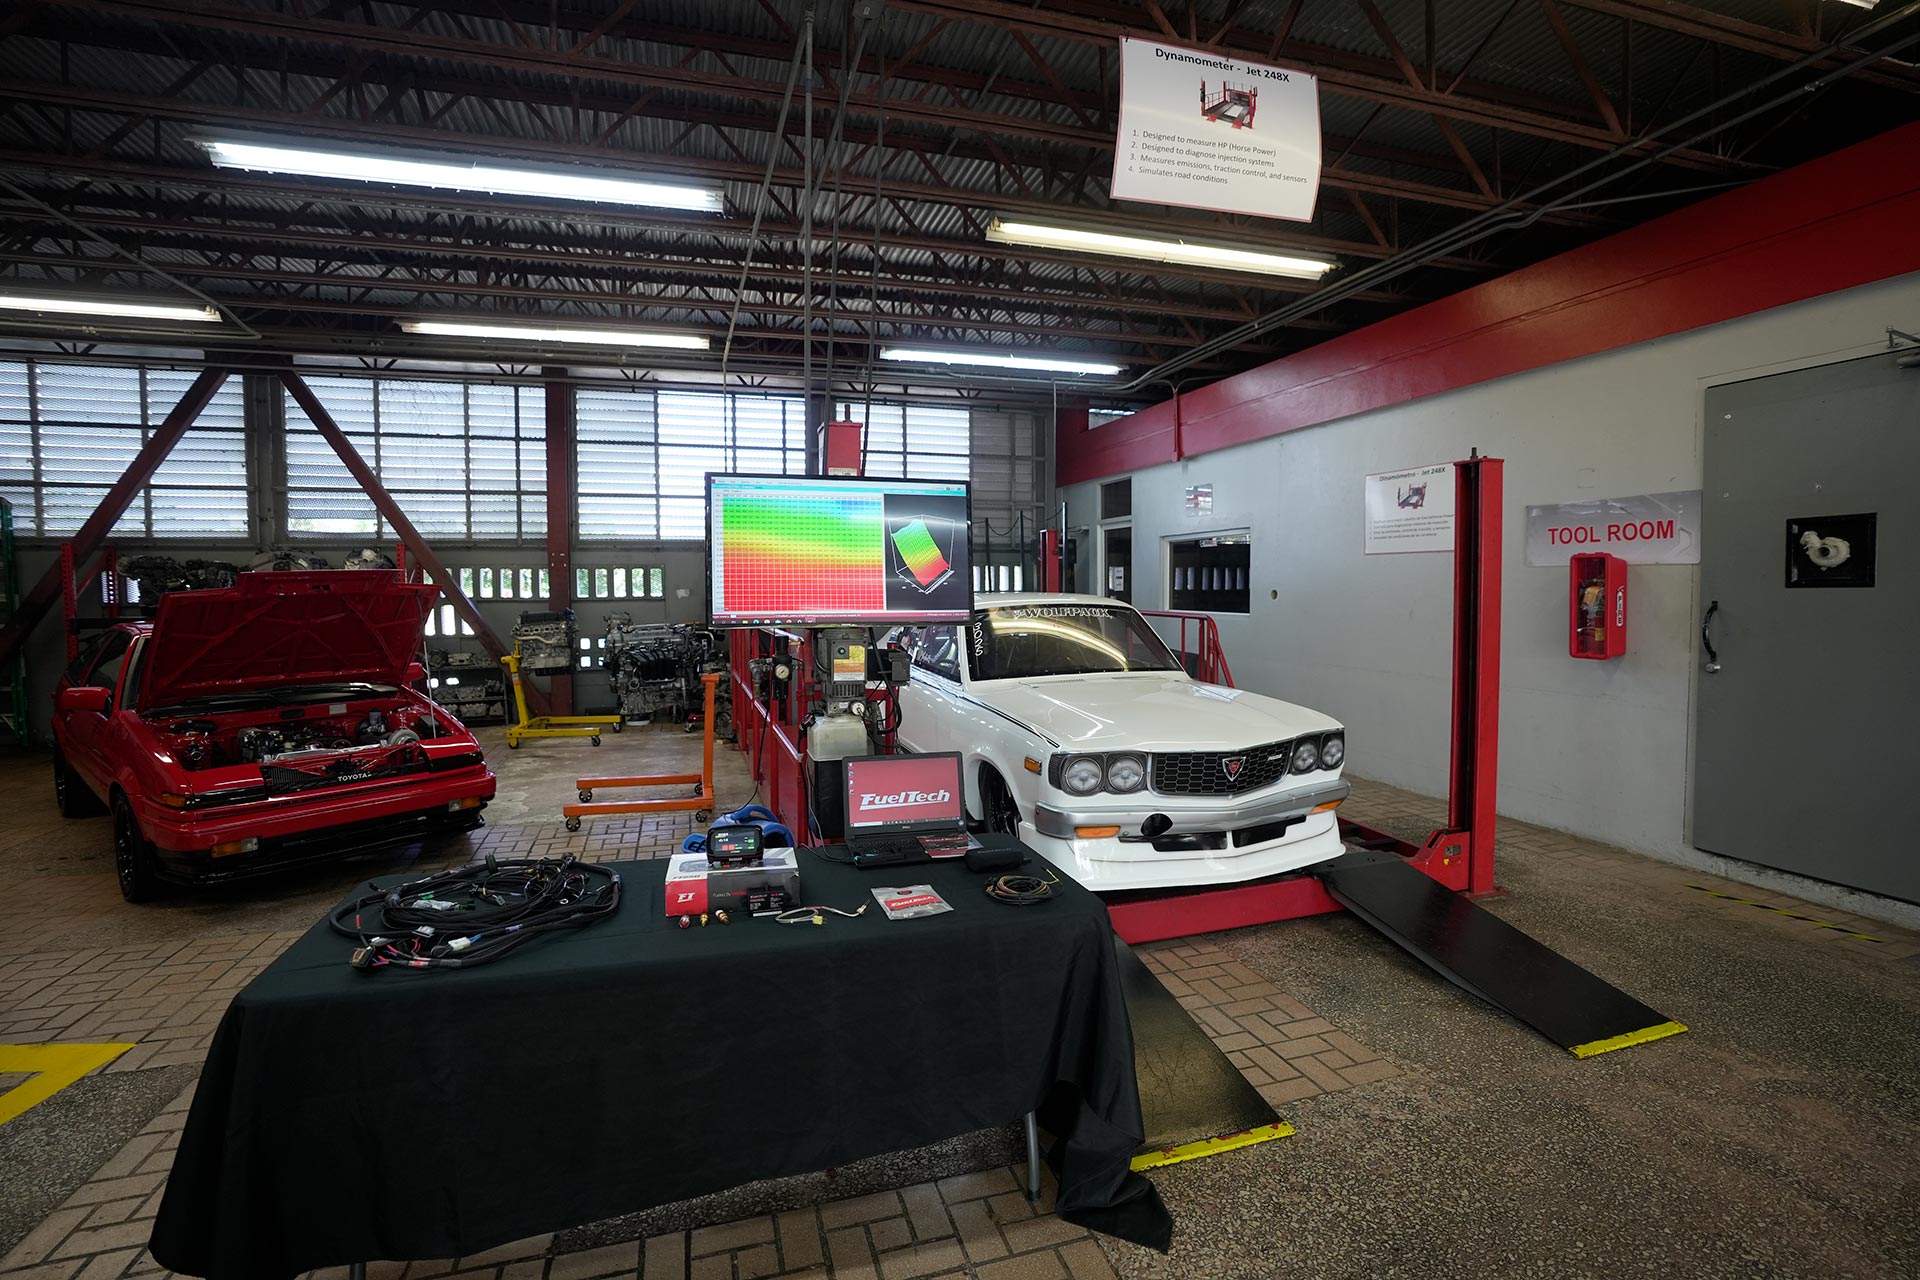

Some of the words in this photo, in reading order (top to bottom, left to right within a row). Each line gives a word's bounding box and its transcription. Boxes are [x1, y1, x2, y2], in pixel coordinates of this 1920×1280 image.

[1155, 48, 1234, 72] Dynamometer
[1246, 66, 1261, 77] Jet
[1264, 69, 1290, 82] 248X
[1133, 129, 1139, 137] 1.
[1143, 131, 1176, 142] Designed
[1186, 139, 1217, 148] measure
[1229, 142, 1252, 153] (Horse
[1253, 146, 1277, 157] Power)
[1131, 141, 1138, 149] 2.
[1142, 142, 1175, 153] Designed
[1176, 147, 1184, 155] to
[1185, 149, 1217, 159] diagnose
[1218, 153, 1247, 163] injection
[1248, 159, 1275, 168] systems
[1130, 153, 1136, 161] 3.
[1140, 154, 1175, 166] Measures
[1176, 160, 1212, 171] emissions,
[1214, 164, 1241, 175] traction
[1242, 169, 1267, 179] control,
[1269, 172, 1282, 180] and
[1283, 174, 1308, 183] sensors
[1139, 166, 1173, 178] Simulates
[1174, 172, 1192, 180] road
[1192, 174, 1228, 184] conditions
[1431, 466, 1446, 475] 248X
[1547, 526, 1601, 545] TOOL
[1607, 520, 1674, 542] ROOM
[1023, 607, 1110, 618] WOLFPACK
[338, 772, 368, 782] TOYOTA
[860, 789, 951, 808] FuelTech
